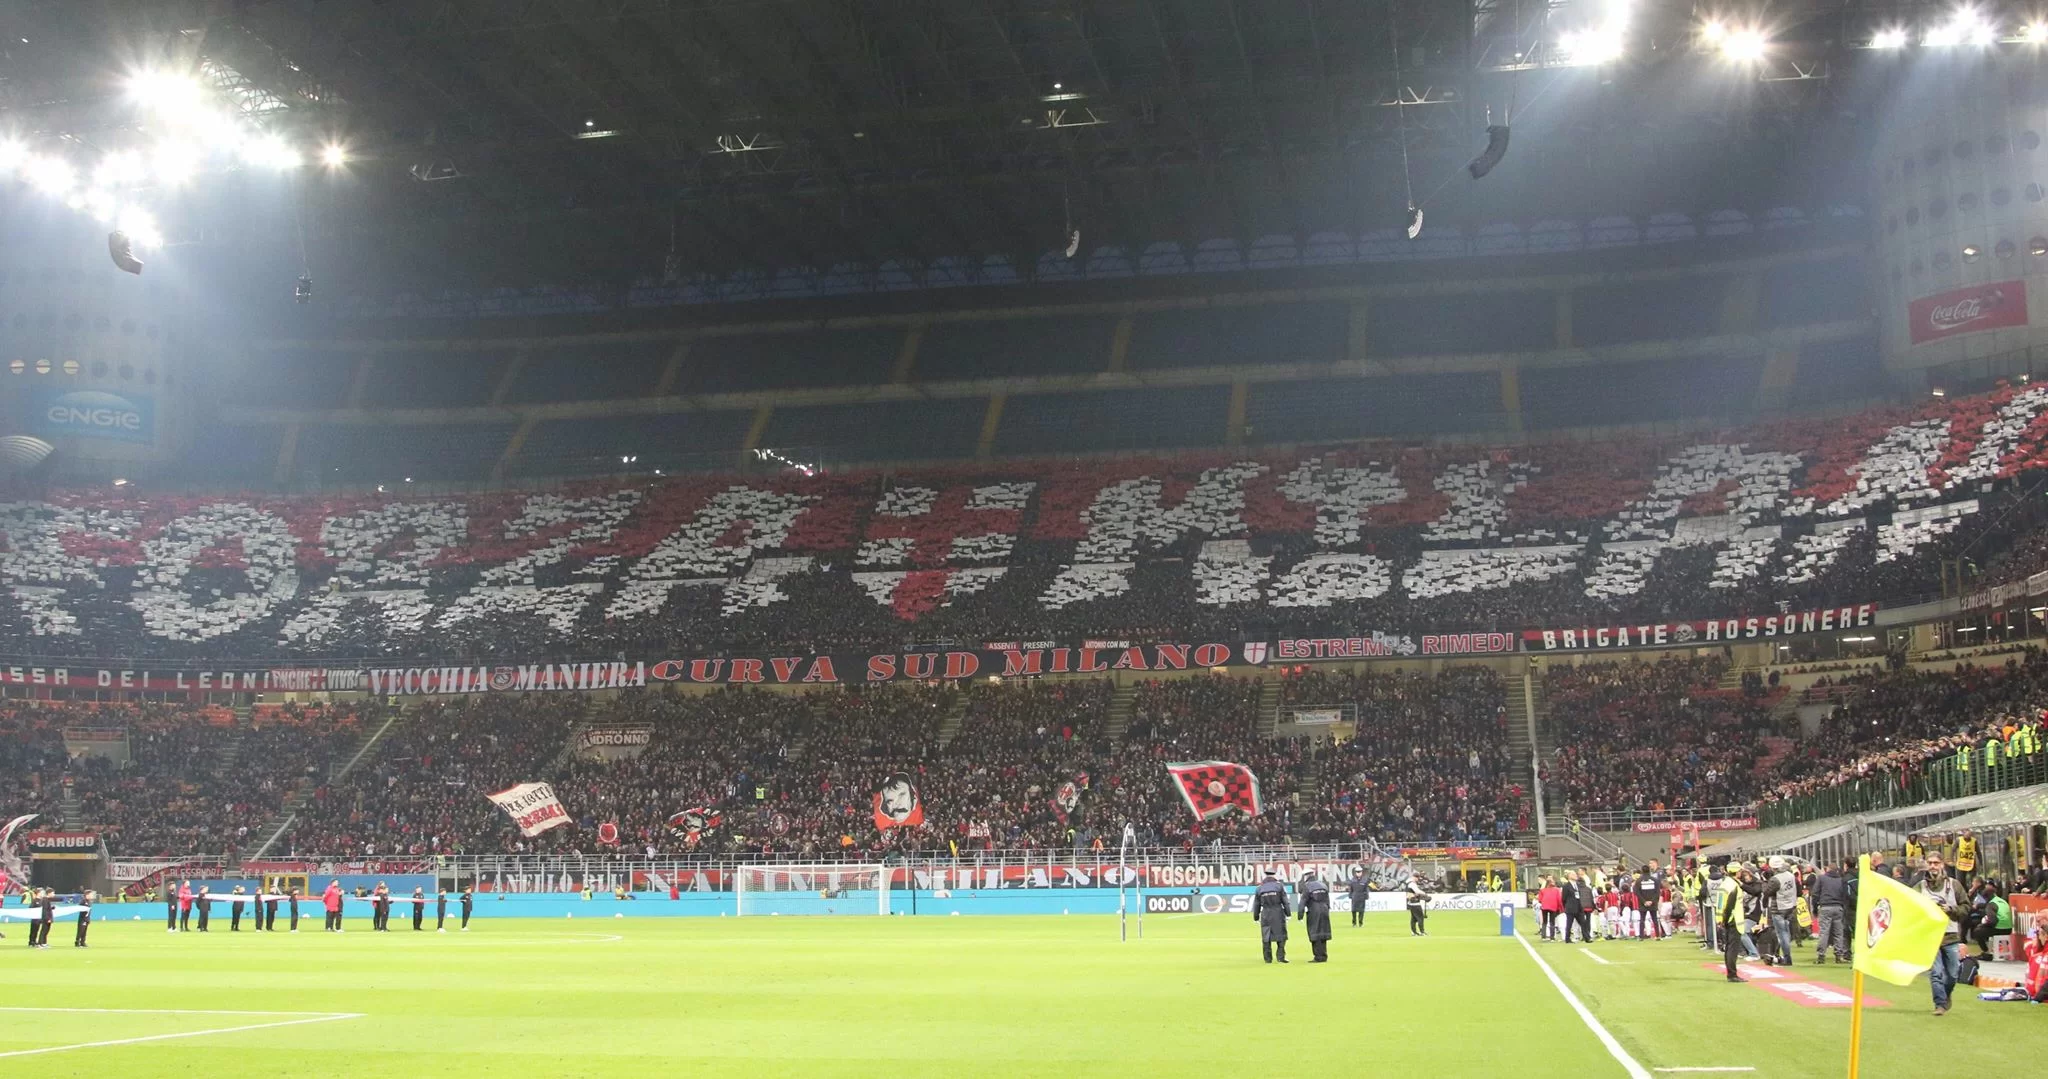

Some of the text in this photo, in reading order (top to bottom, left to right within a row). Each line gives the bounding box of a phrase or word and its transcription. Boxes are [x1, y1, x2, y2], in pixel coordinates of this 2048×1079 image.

[1542, 604, 1872, 650] BRIGATE ROSSONERE
[1023, 641, 1056, 649] PRESENTI
[1422, 632, 1514, 655] RIMEDI
[651, 643, 1231, 684] CURVA SUD MILANO
[0, 666, 270, 690] SSA DEI LEONI
[369, 661, 646, 696] VECCHIA MANIERA
[37, 836, 95, 848] CARUGO
[1150, 864, 1254, 886] TOSCOLANO
[1149, 897, 1190, 912] 00:00
